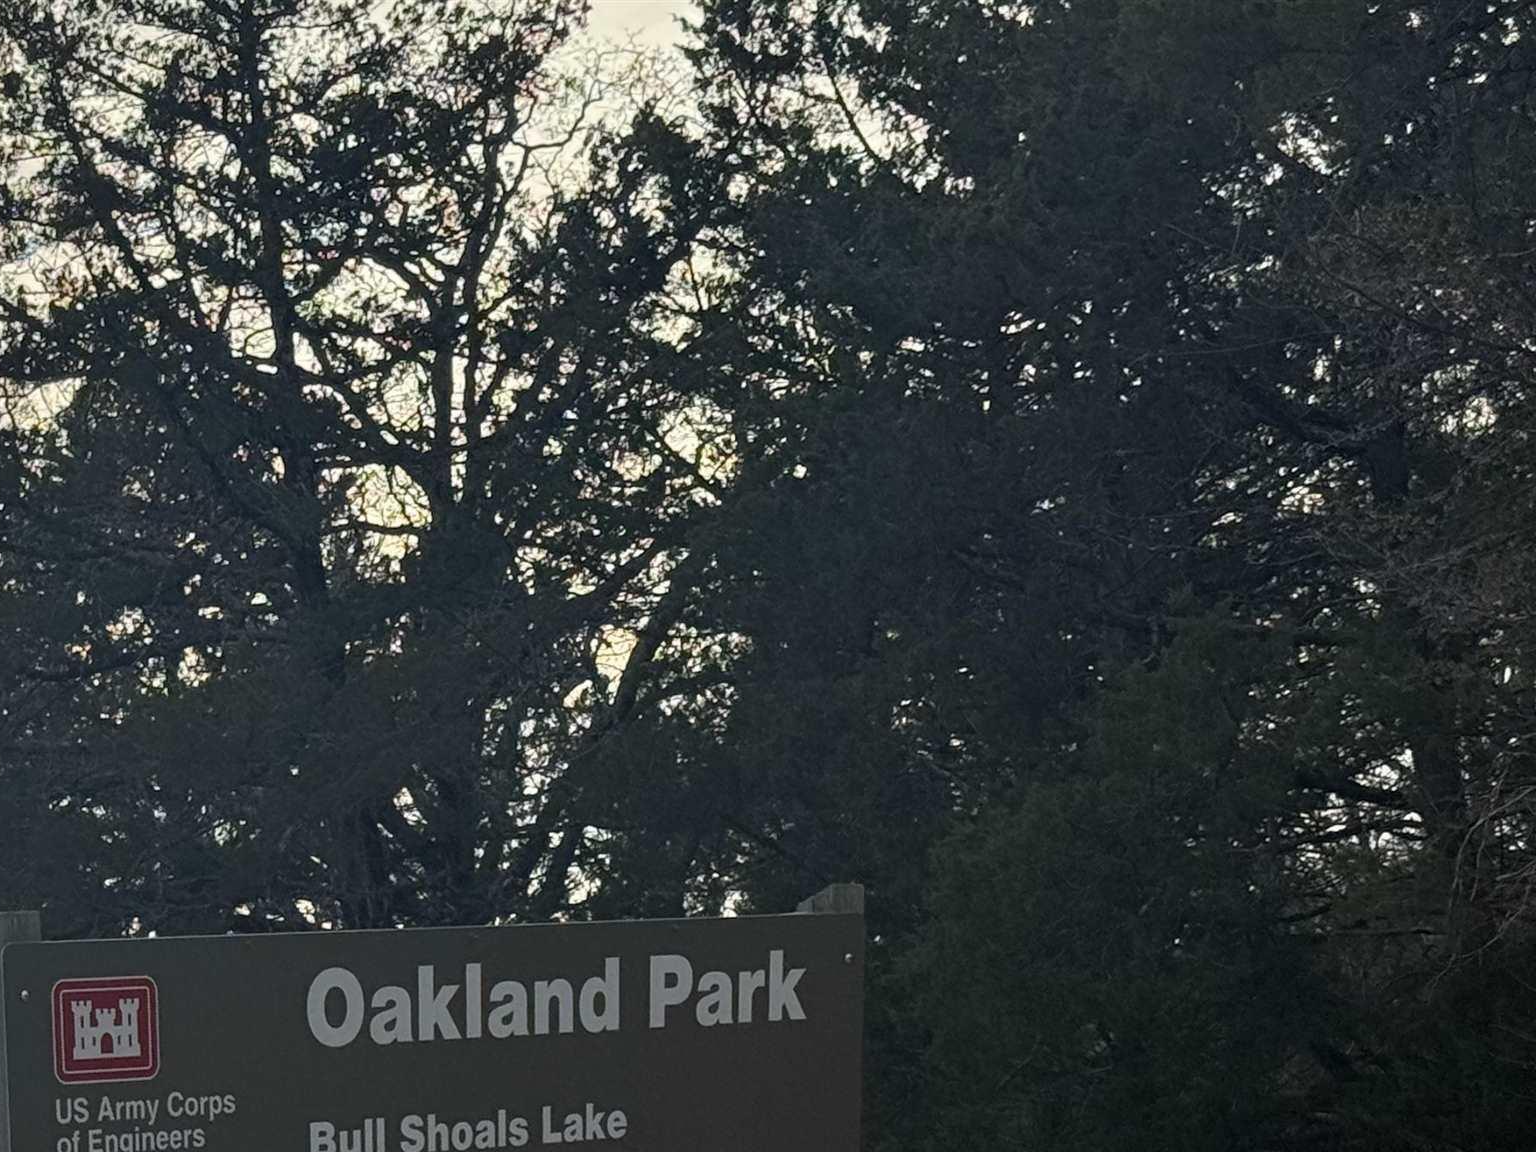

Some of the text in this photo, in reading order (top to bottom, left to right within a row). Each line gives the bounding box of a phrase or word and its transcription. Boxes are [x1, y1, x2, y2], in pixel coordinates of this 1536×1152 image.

[306, 949, 807, 1048] Oakland Park
[55, 1091, 236, 1126] US Army Corps
[542, 1102, 628, 1144] Lake
